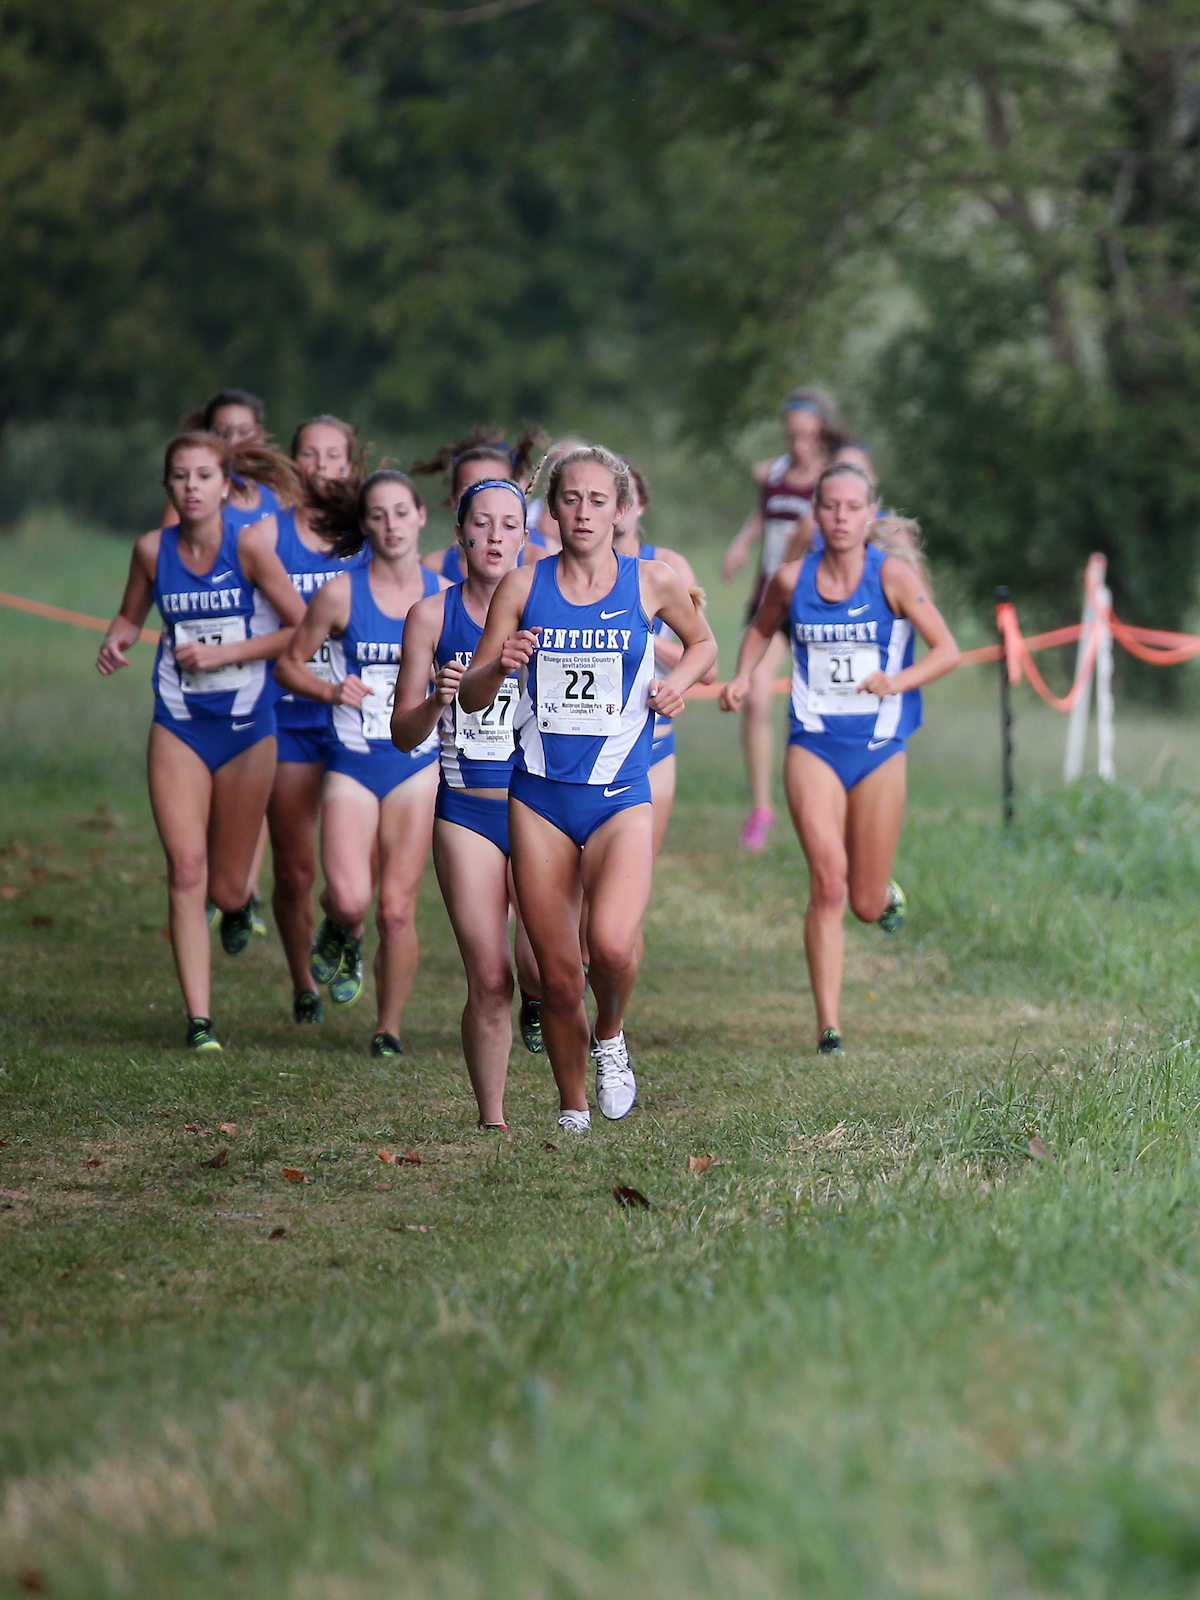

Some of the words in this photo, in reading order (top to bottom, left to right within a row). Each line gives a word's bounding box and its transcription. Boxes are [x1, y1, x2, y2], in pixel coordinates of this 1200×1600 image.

[162, 588, 241, 612] KENTUCKY
[796, 621, 878, 642] KENTUCKY
[543, 655, 572, 664] Bluegrass
[592, 656, 616, 664] Country
[830, 656, 855, 683] 21
[564, 670, 595, 700] 22
[481, 695, 511, 726] 27
